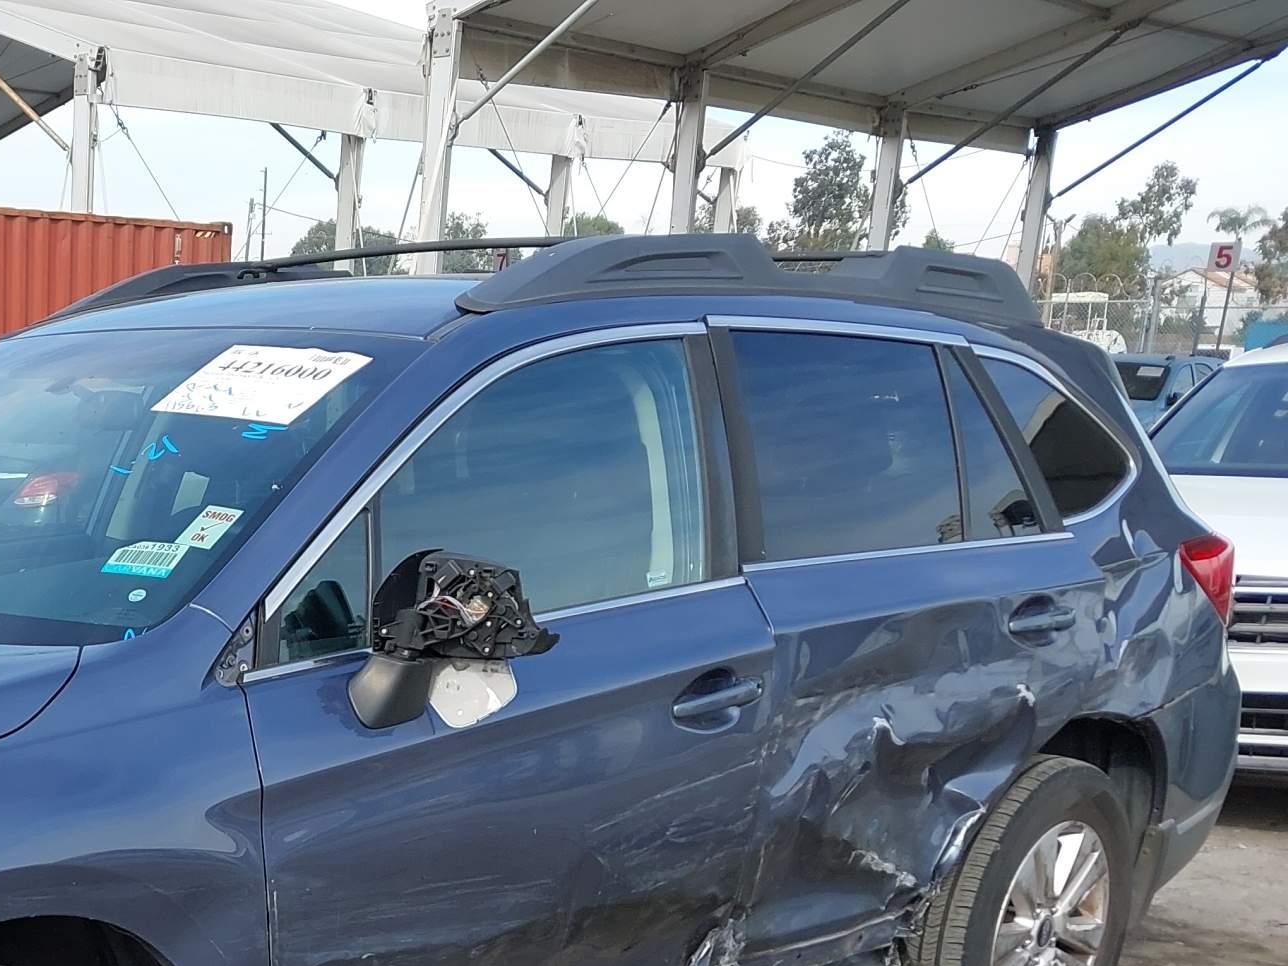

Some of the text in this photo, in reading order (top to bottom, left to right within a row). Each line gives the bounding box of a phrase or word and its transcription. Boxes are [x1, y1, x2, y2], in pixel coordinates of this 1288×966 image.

[1214, 245, 1234, 269] 5
[218, 359, 333, 381] 44216000
[201, 510, 236, 523] SMOG
[190, 532, 209, 544] OK
